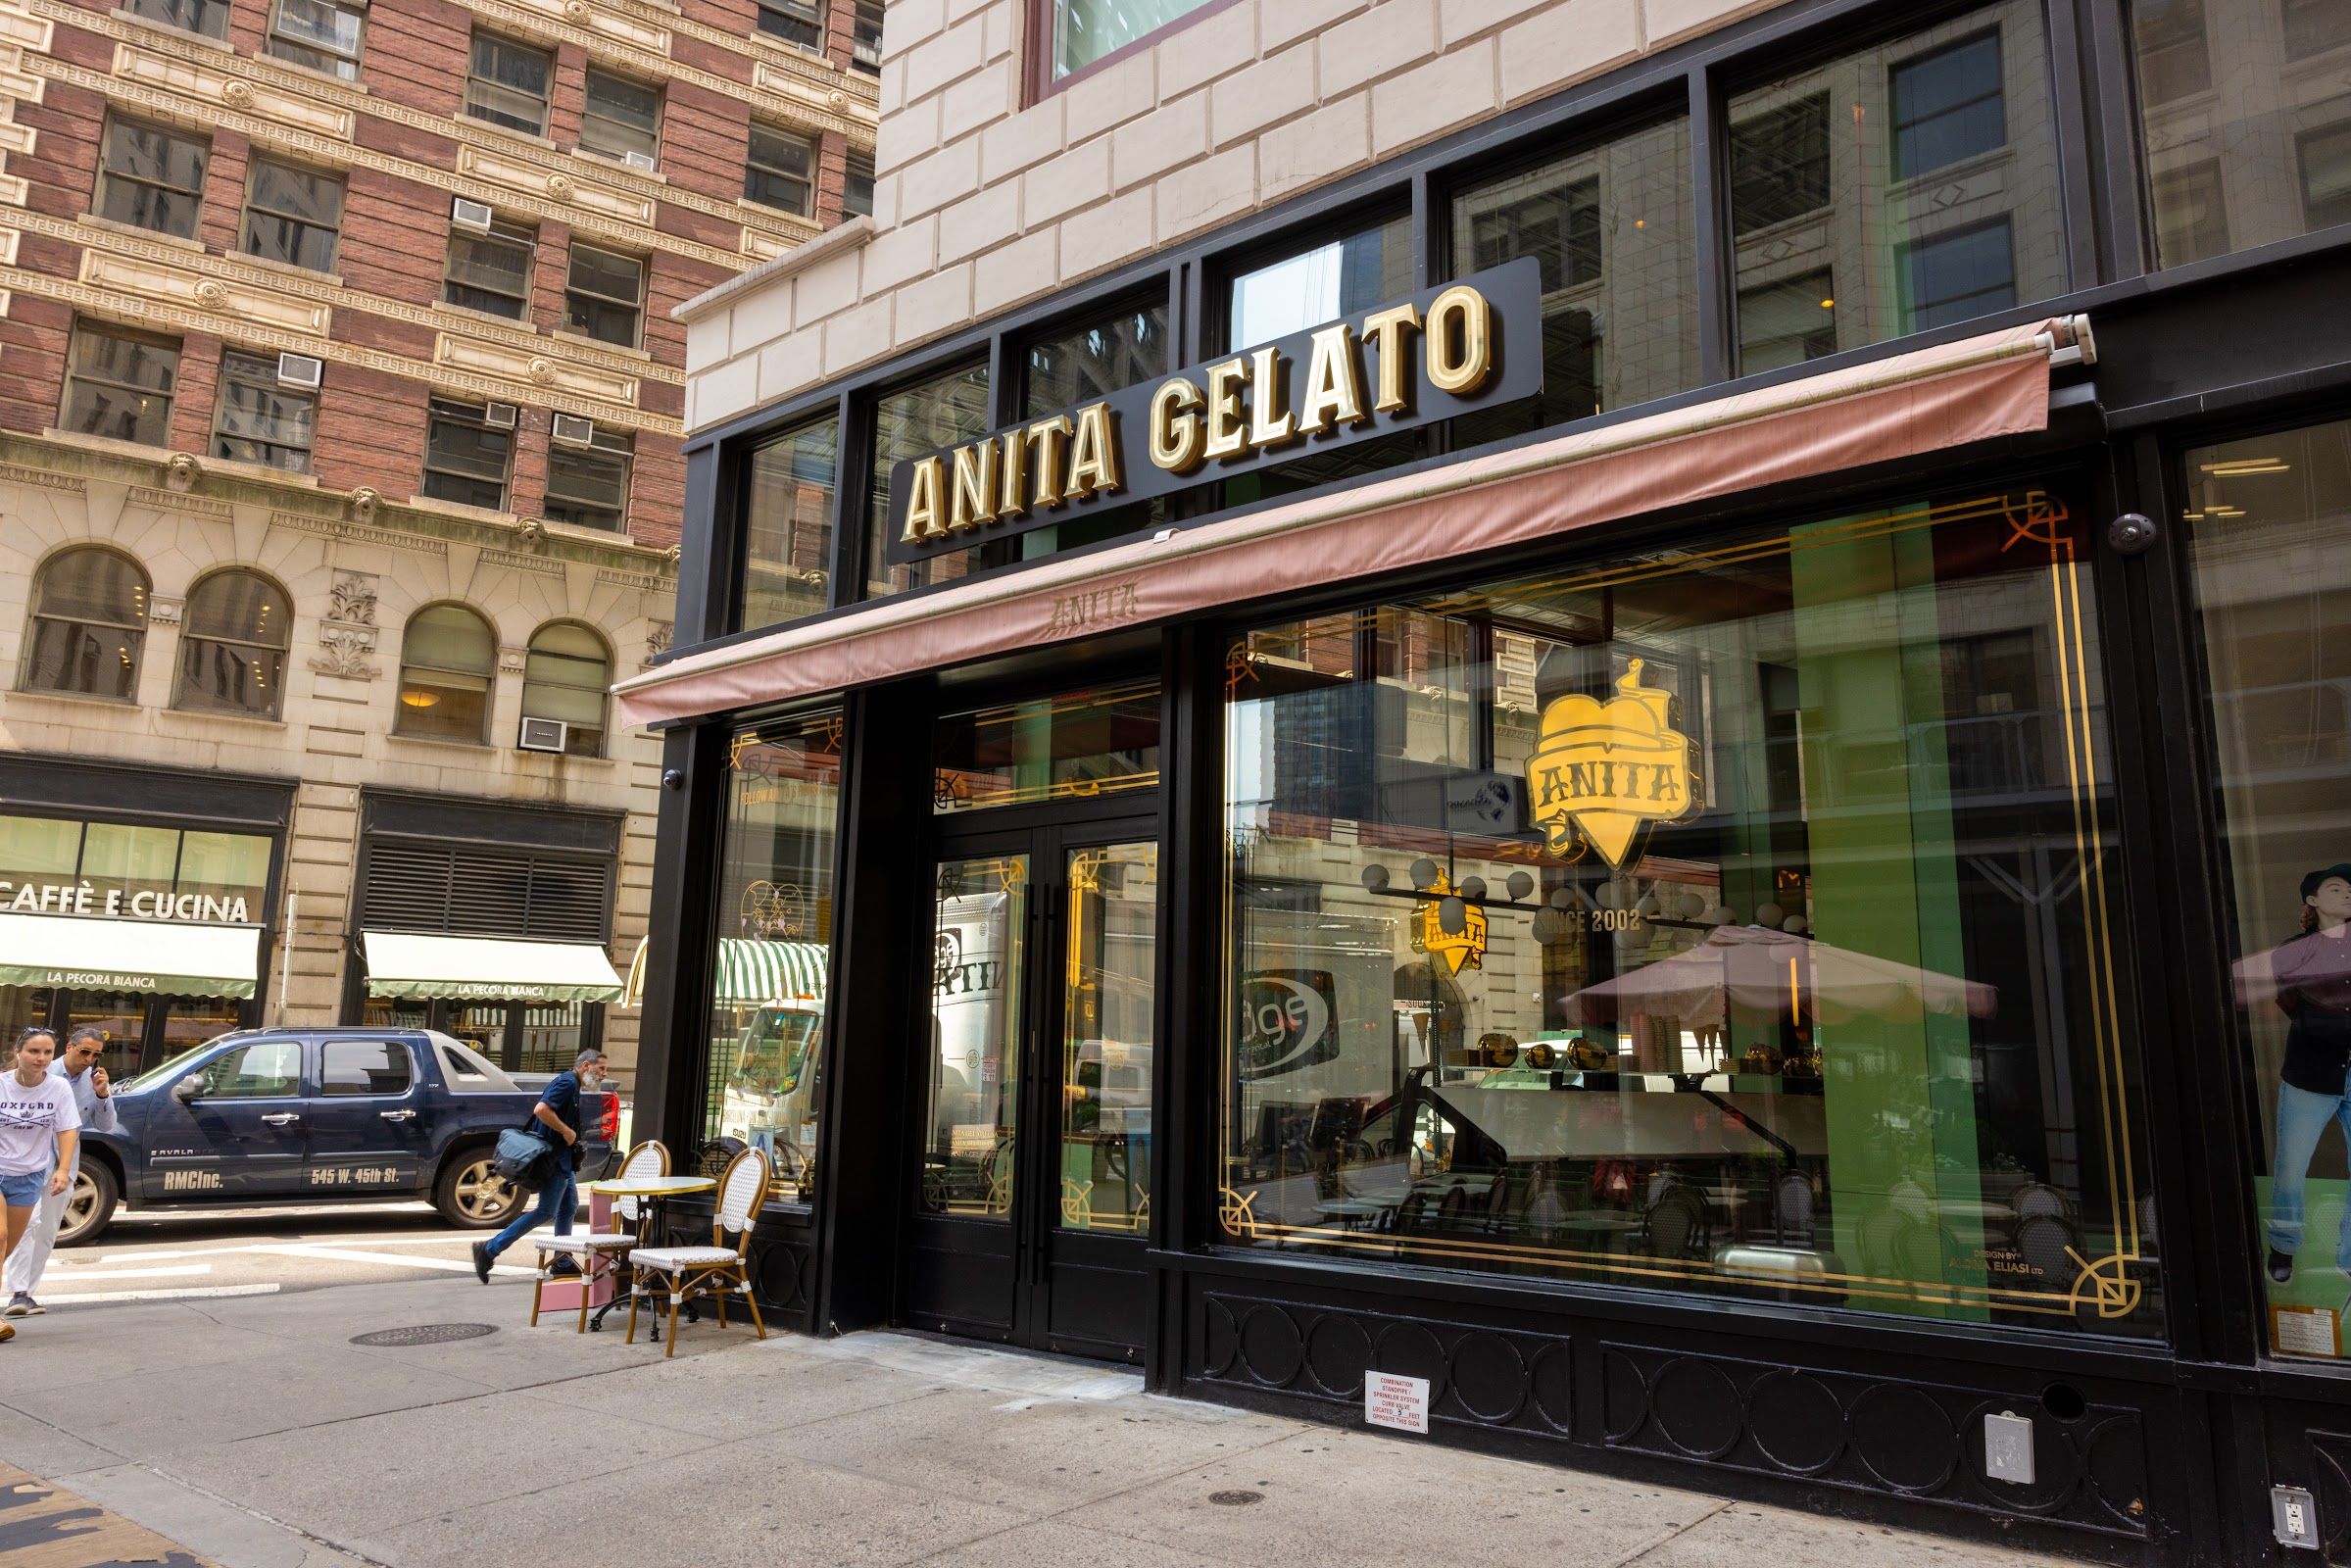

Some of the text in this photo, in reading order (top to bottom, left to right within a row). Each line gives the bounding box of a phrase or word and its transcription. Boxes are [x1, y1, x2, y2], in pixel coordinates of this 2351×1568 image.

[899, 286, 1491, 545] ANITA GELATO
[1051, 583, 1138, 631] ANITA
[1538, 759, 1679, 808] ANITA
[105, 889, 122, 915] E
[131, 891, 249, 922] CUCINA
[1592, 909, 1641, 932] 2002
[1427, 921, 1484, 944] ATA
[47, 971, 156, 989] LA PECORA BIANCA
[458, 985, 544, 997] LA PECORA BIANCA
[733, 1128, 747, 1139] ISUZU
[311, 1167, 400, 1185] 545 W. 45th St.
[1974, 1250, 2017, 1260] DESIGN BY
[1993, 1261, 2030, 1274] ELIASI
[1380, 1377, 1414, 1388] COMBINATION
[1382, 1385, 1408, 1395] STANDPIPE
[1373, 1391, 1420, 1404] SPRINKLER SYSTEM
[1372, 1405, 1394, 1414] LOCATED
[1372, 1413, 1396, 1422] OPPOSITE
